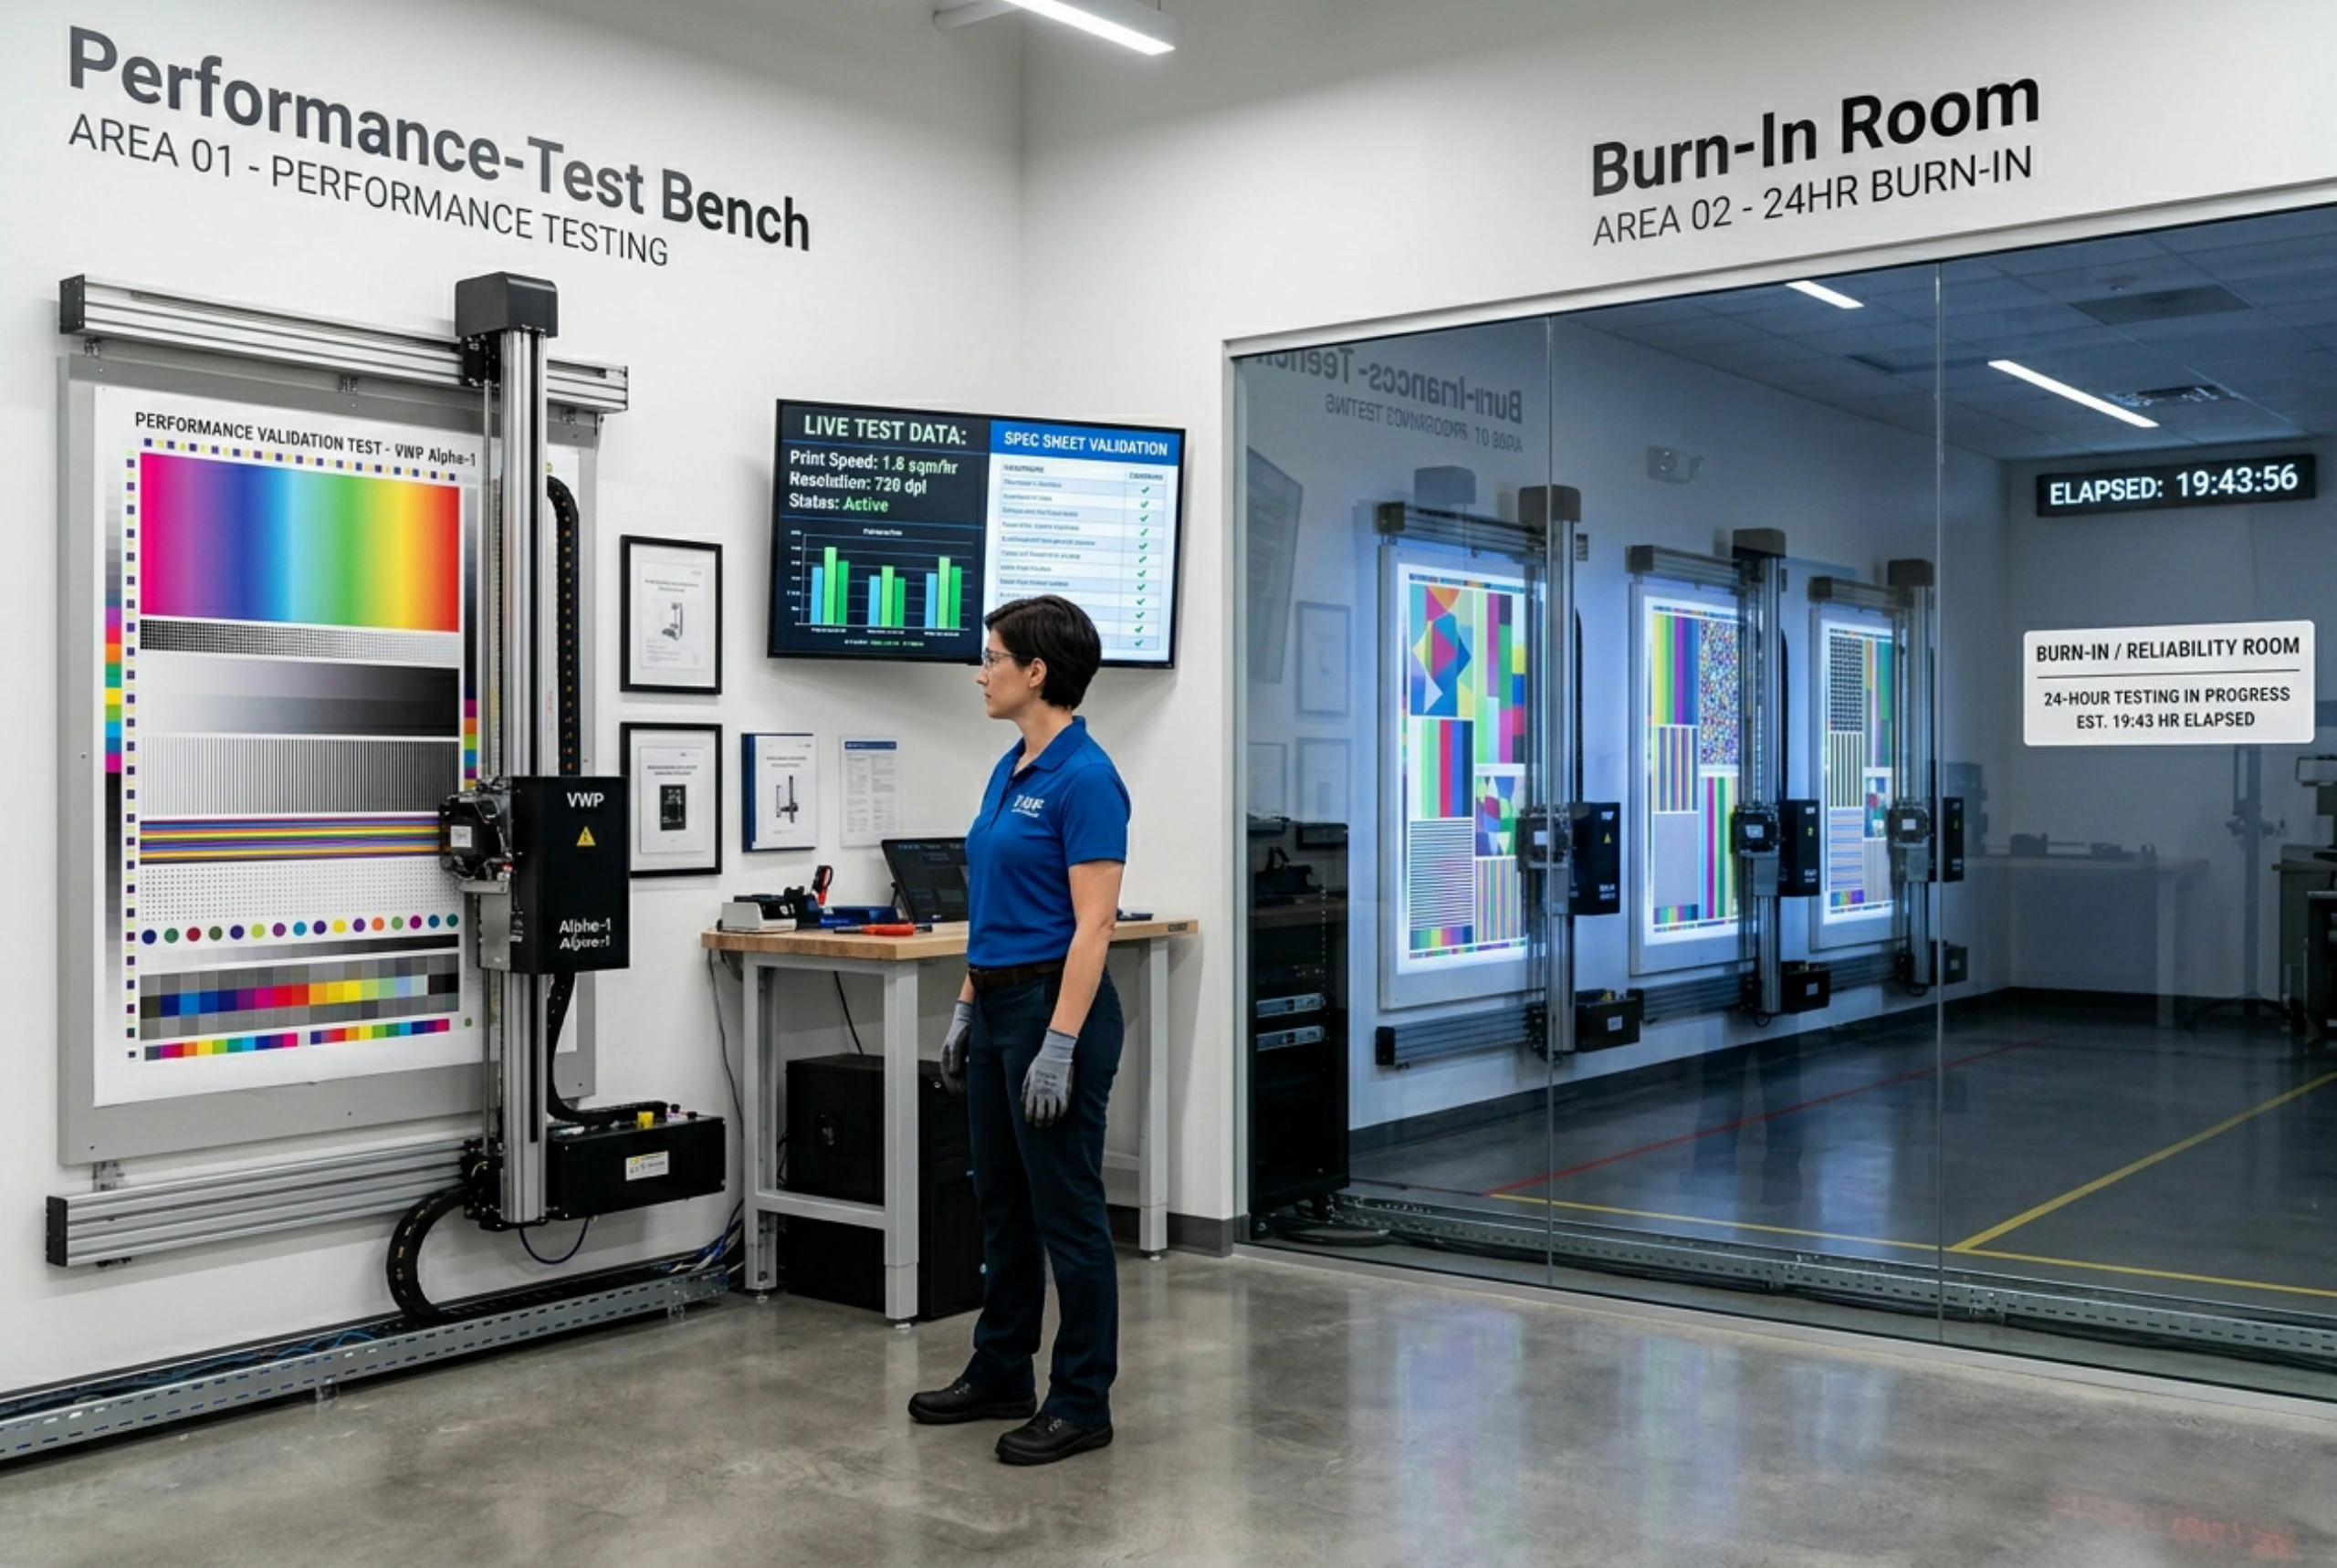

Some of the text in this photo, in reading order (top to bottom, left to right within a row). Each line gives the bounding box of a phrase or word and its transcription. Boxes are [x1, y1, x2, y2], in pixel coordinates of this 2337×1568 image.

[68, 26, 810, 251] Performance-Test Bench
[1593, 77, 2039, 197] Burn-In Room
[68, 113, 179, 168] AREA
[191, 140, 233, 178] 01
[272, 155, 533, 240] PERFORMANCE
[542, 214, 668, 267] TESTING
[1593, 204, 1681, 246] AREA
[1691, 195, 1732, 230] 02
[1763, 175, 1859, 220] 24HR
[1871, 145, 2031, 202] BURN-IN
[135, 412, 254, 441] PERFORMANCE
[257, 426, 344, 451] VALIDATION
[347, 438, 383, 455] TEST
[804, 414, 968, 445] LIVE TEST DATA:
[1004, 430, 1040, 447] SPEC
[1089, 437, 1168, 456] VALIDATION
[790, 450, 825, 467] Print
[829, 453, 878, 471] Speed:
[2049, 463, 2299, 506] ELAPSED: 19:43:56
[843, 497, 889, 513] Active
[2037, 637, 2300, 663] BURN-IN / RELIABILITY ROOM
[2044, 686, 2290, 706] 24-HOUR TESTING IN PROGRESS
[2077, 711, 2255, 729] EST. 19:43 HR ELAPSED
[567, 792, 605, 808] VWP
